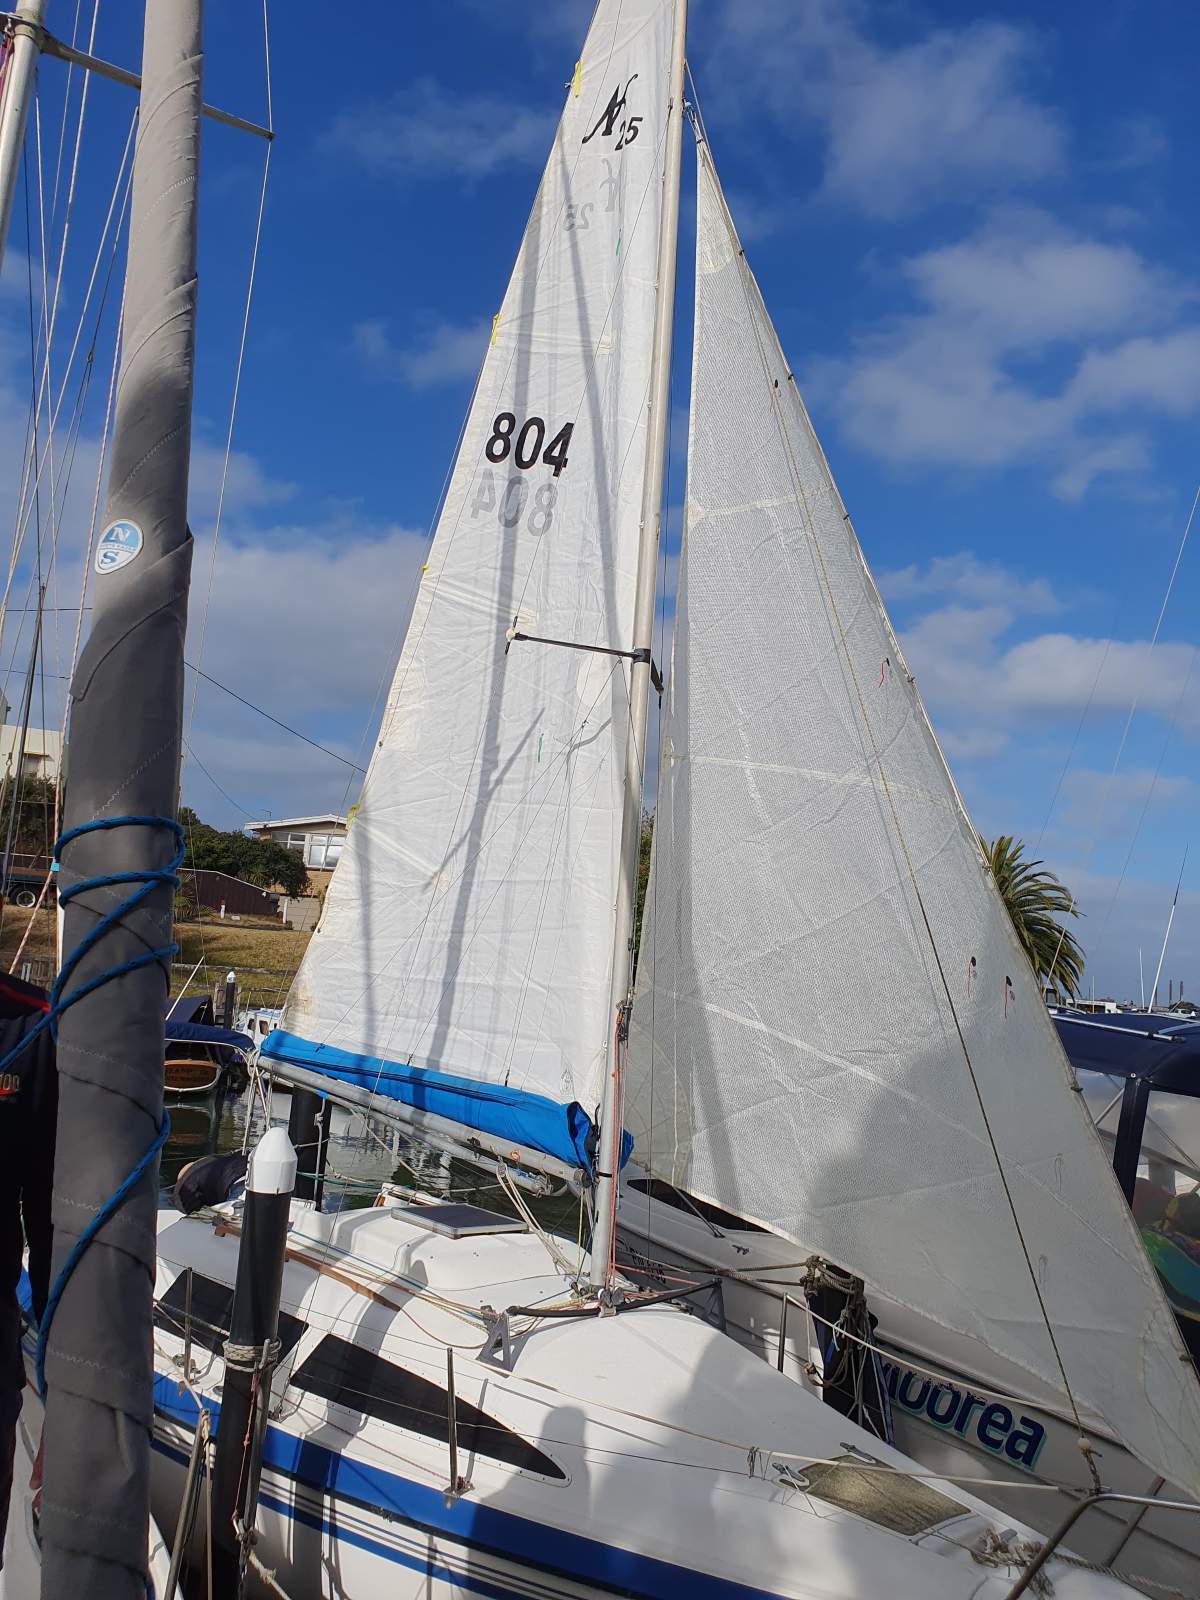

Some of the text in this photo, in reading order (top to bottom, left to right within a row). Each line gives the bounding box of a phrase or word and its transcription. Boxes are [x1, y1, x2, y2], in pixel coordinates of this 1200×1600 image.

[615, 117, 643, 151] 25
[486, 412, 574, 477] 804
[109, 527, 130, 543] N
[101, 551, 119, 565] S
